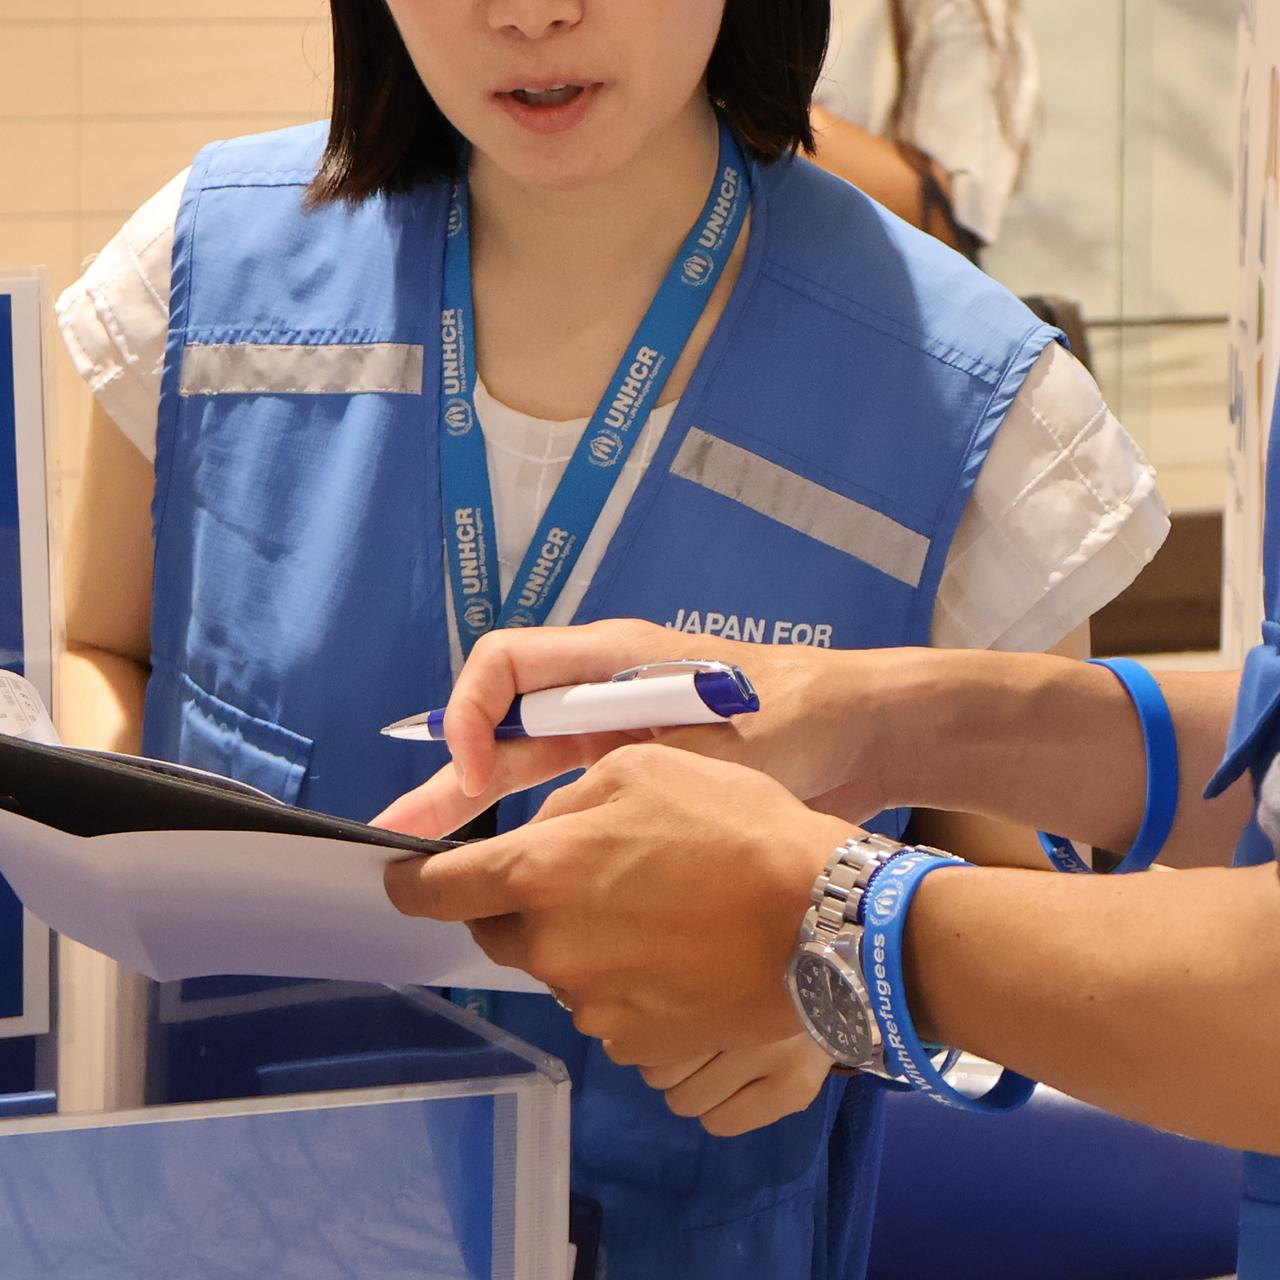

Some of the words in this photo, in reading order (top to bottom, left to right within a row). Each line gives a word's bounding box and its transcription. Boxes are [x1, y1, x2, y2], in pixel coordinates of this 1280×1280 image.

[698, 166, 738, 248] UNHCR
[442, 308, 460, 395] UNHCR
[604, 346, 658, 428] UNHCR
[455, 507, 482, 595] UNHCR
[518, 527, 569, 608] UNHCR
[665, 608, 766, 643] JAPAN
[772, 620, 833, 648] FOR
